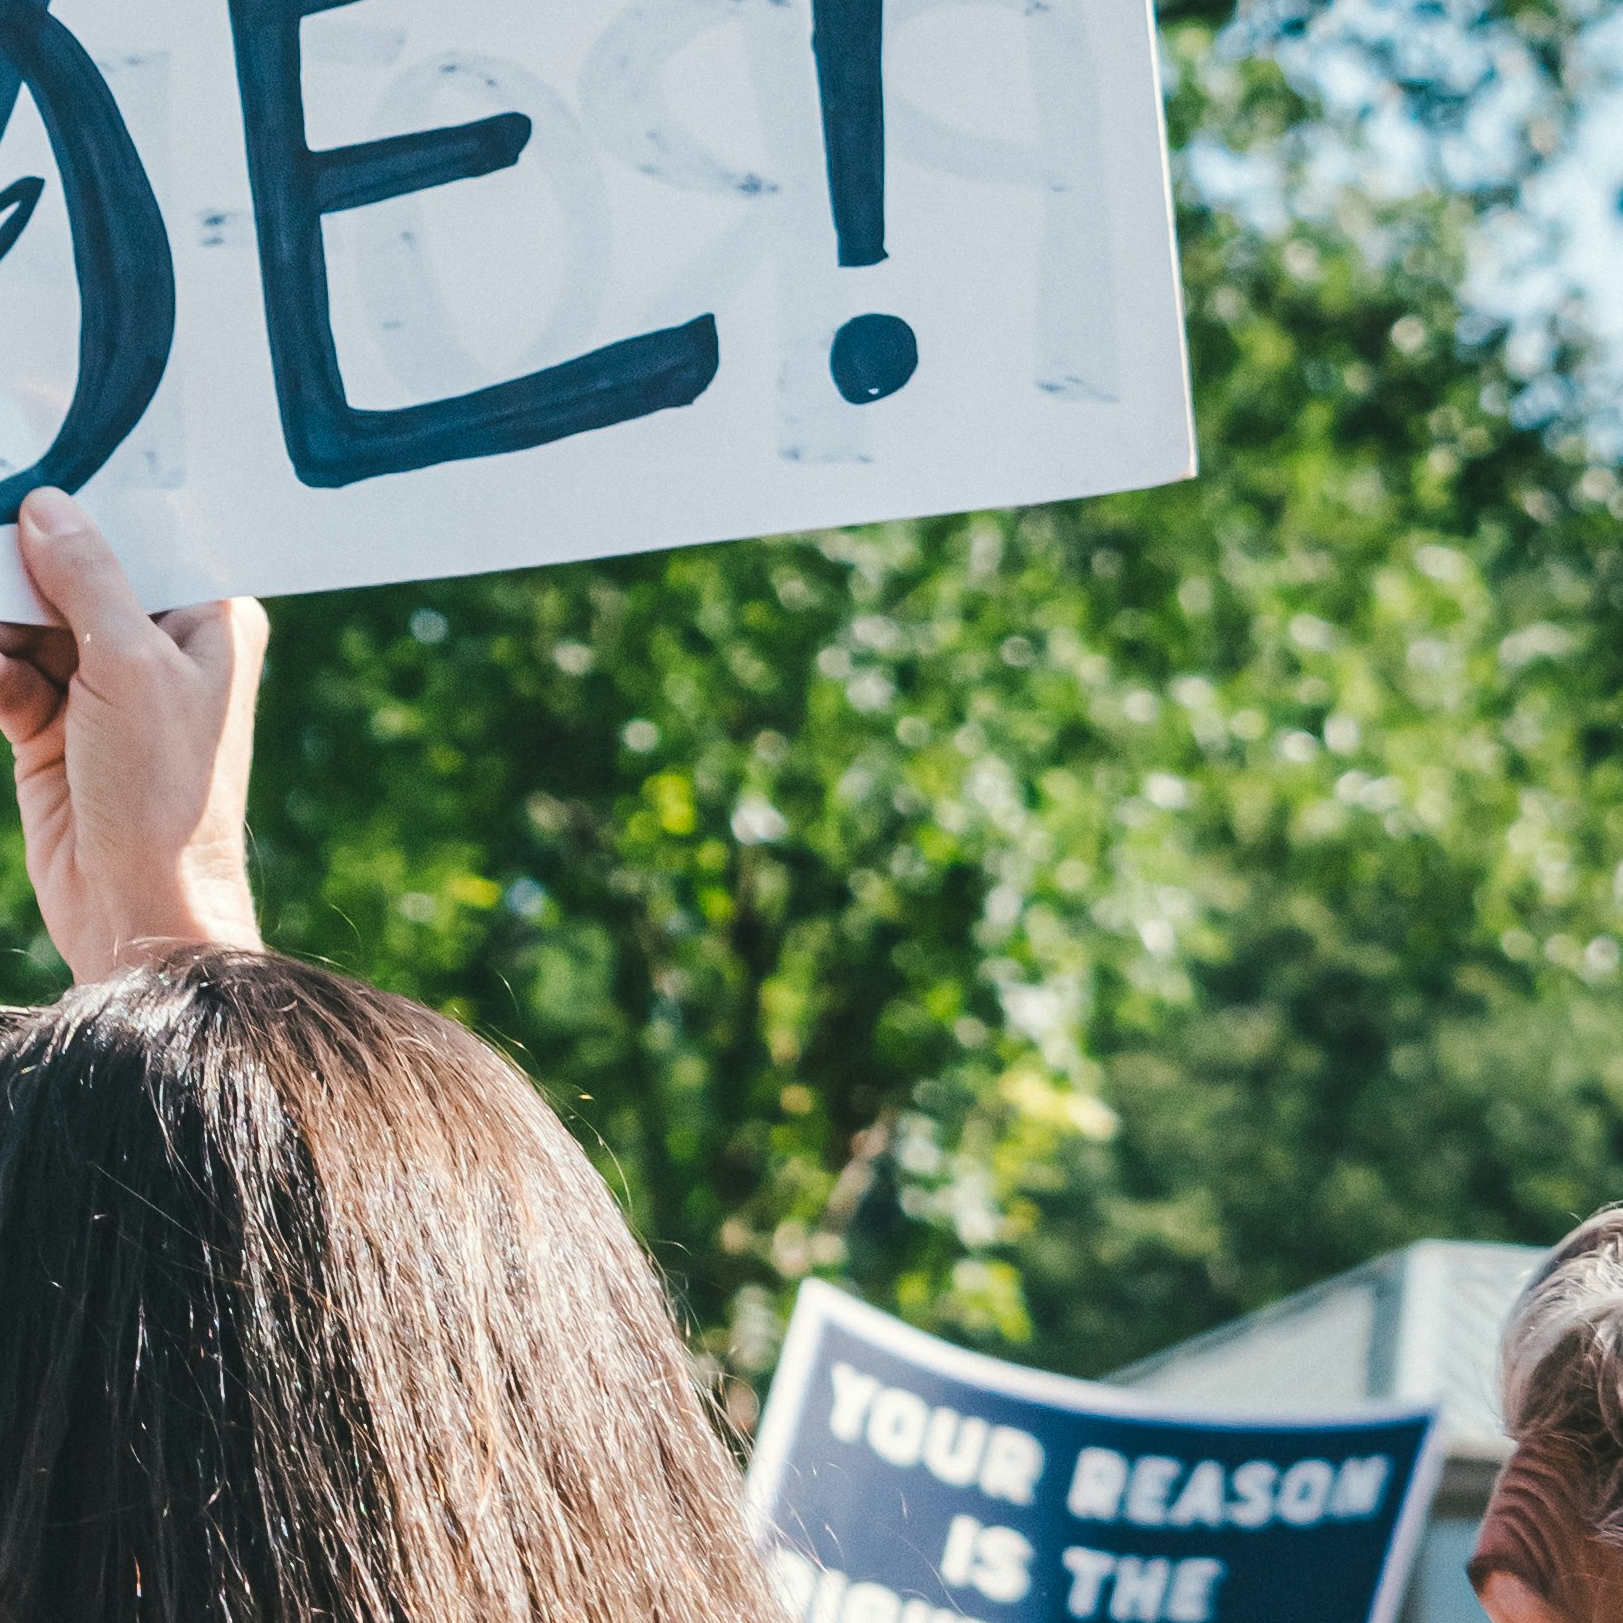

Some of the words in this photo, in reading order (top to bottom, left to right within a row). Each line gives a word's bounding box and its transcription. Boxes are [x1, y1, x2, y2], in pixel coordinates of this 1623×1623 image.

[829, 1362, 1046, 1506] YOUR
[1067, 1446, 1390, 1530] REASON
[938, 1514, 1035, 1603] IS
